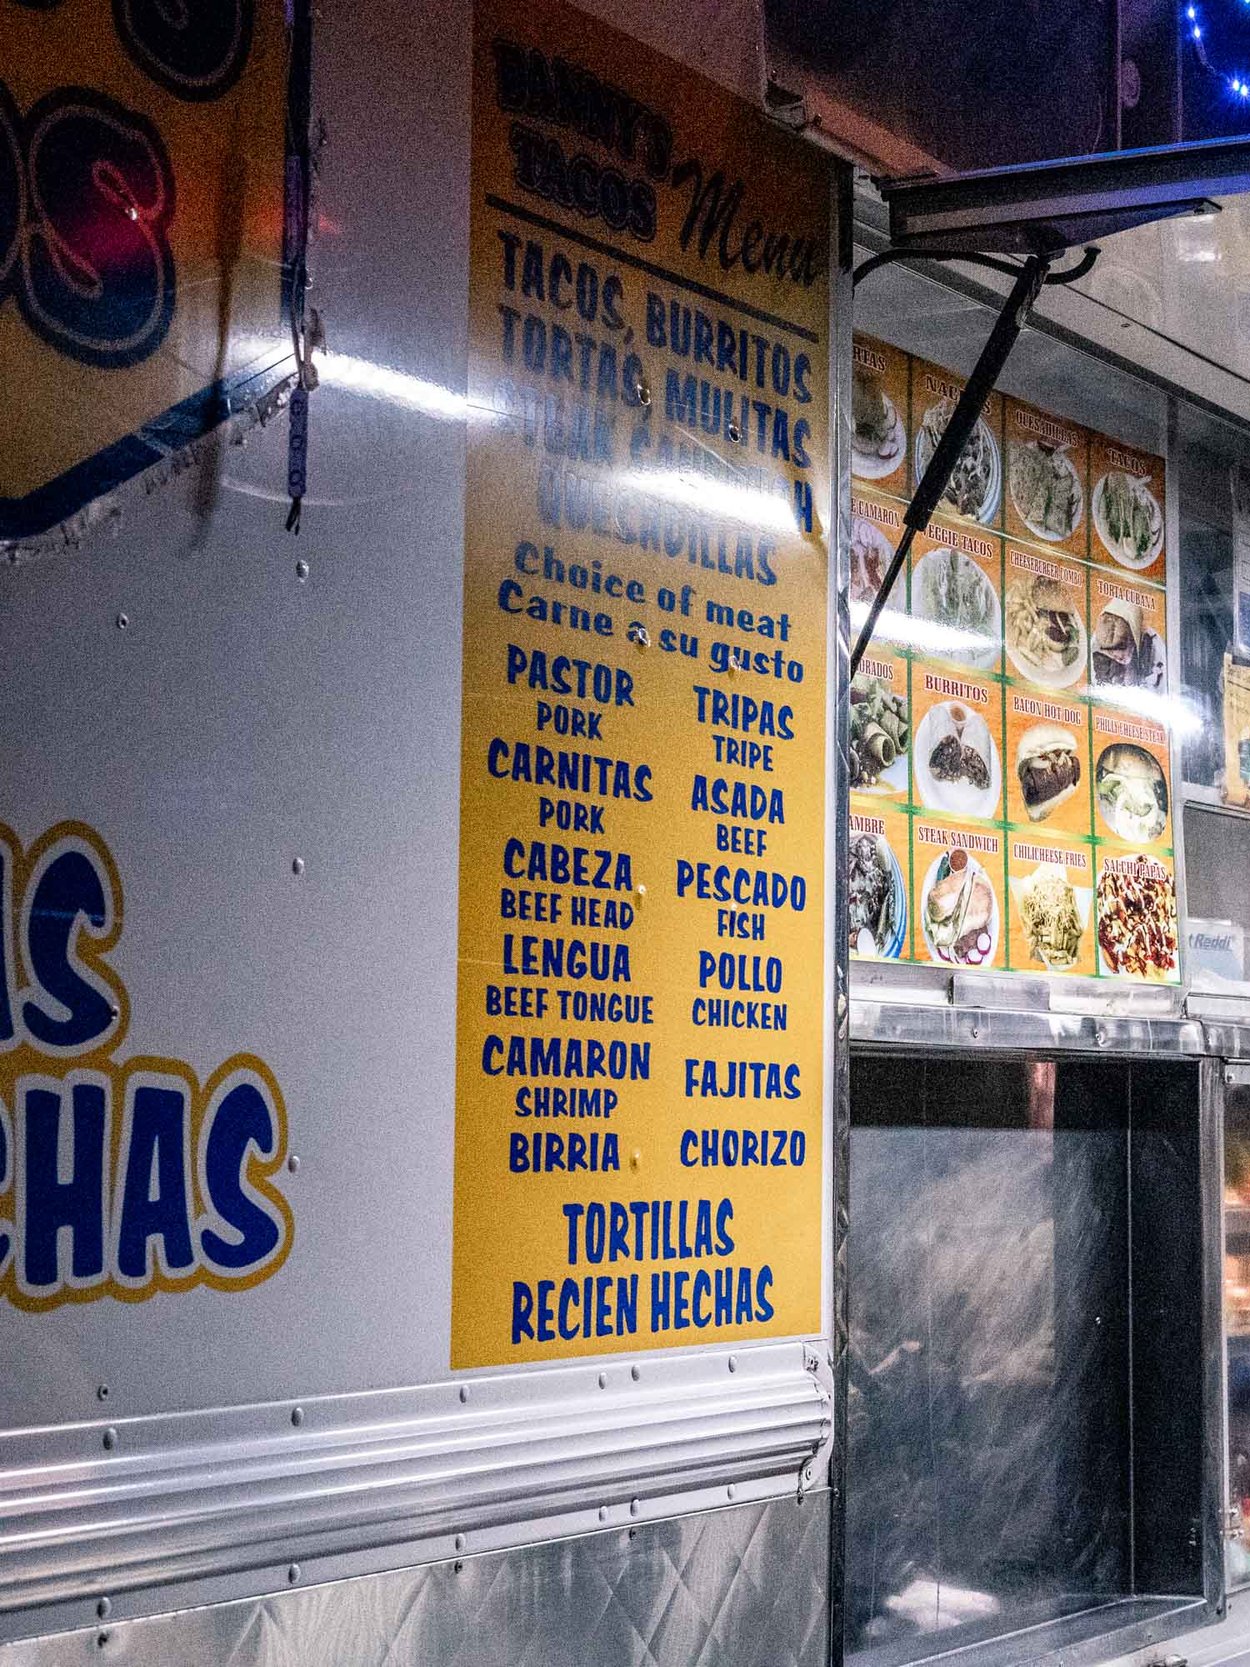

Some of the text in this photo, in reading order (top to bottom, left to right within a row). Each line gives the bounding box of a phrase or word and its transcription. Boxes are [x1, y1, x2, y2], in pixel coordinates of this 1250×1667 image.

[509, 122, 656, 243] TACOS
[673, 162, 824, 287] Menu
[499, 230, 812, 404] TACOS, BURRITOS
[926, 375, 991, 414] NACS
[666, 368, 812, 469] MULITAS
[1015, 409, 1079, 448] QUESADILLAS
[1108, 448, 1147, 476] TACOS
[859, 501, 900, 527] CAMARON
[961, 533, 994, 559] TACOS
[1010, 550, 1083, 587] CHEESEBURGER COMBO
[514, 541, 792, 642] Choice of meat
[1097, 579, 1156, 609] TORTA CUBANA
[497, 578, 805, 685] Carne a su gusto
[506, 643, 636, 708] PASTOR
[857, 657, 894, 681] ORADOS
[924, 673, 989, 703] BURRITOS
[536, 701, 604, 740] PORK
[692, 684, 795, 741] TRIPAS
[1013, 695, 1082, 726] BACON HOT DOG
[486, 737, 655, 802] CARNITAS
[712, 734, 775, 772] TRIPE
[538, 796, 606, 835] PORK
[690, 774, 786, 825] ASADA
[715, 823, 768, 857] BEEF
[918, 826, 999, 853] STEAK SANDWICH
[1065, 851, 1087, 868] FRIES
[502, 836, 634, 892] CABEZA
[675, 858, 808, 912] PESCADO
[499, 888, 635, 931] BEEF HEAD
[716, 908, 766, 941] FISH
[502, 934, 632, 984] LENGUA
[698, 949, 784, 994] POLLO
[485, 985, 655, 1025] BEEF TONGUE
[691, 997, 788, 1031] CHICKEN
[480, 1034, 651, 1081] CAMARON
[684, 1058, 802, 1100] FAJITAS
[514, 1086, 619, 1119] SHRIMP
[508, 1131, 621, 1174] BIRRIA
[679, 1129, 808, 1168] CHORIZO
[0, 1070, 287, 1298] HAS
[562, 1196, 736, 1266] TORTILLAS
[510, 1264, 776, 1345] RECIEN HECHAS
